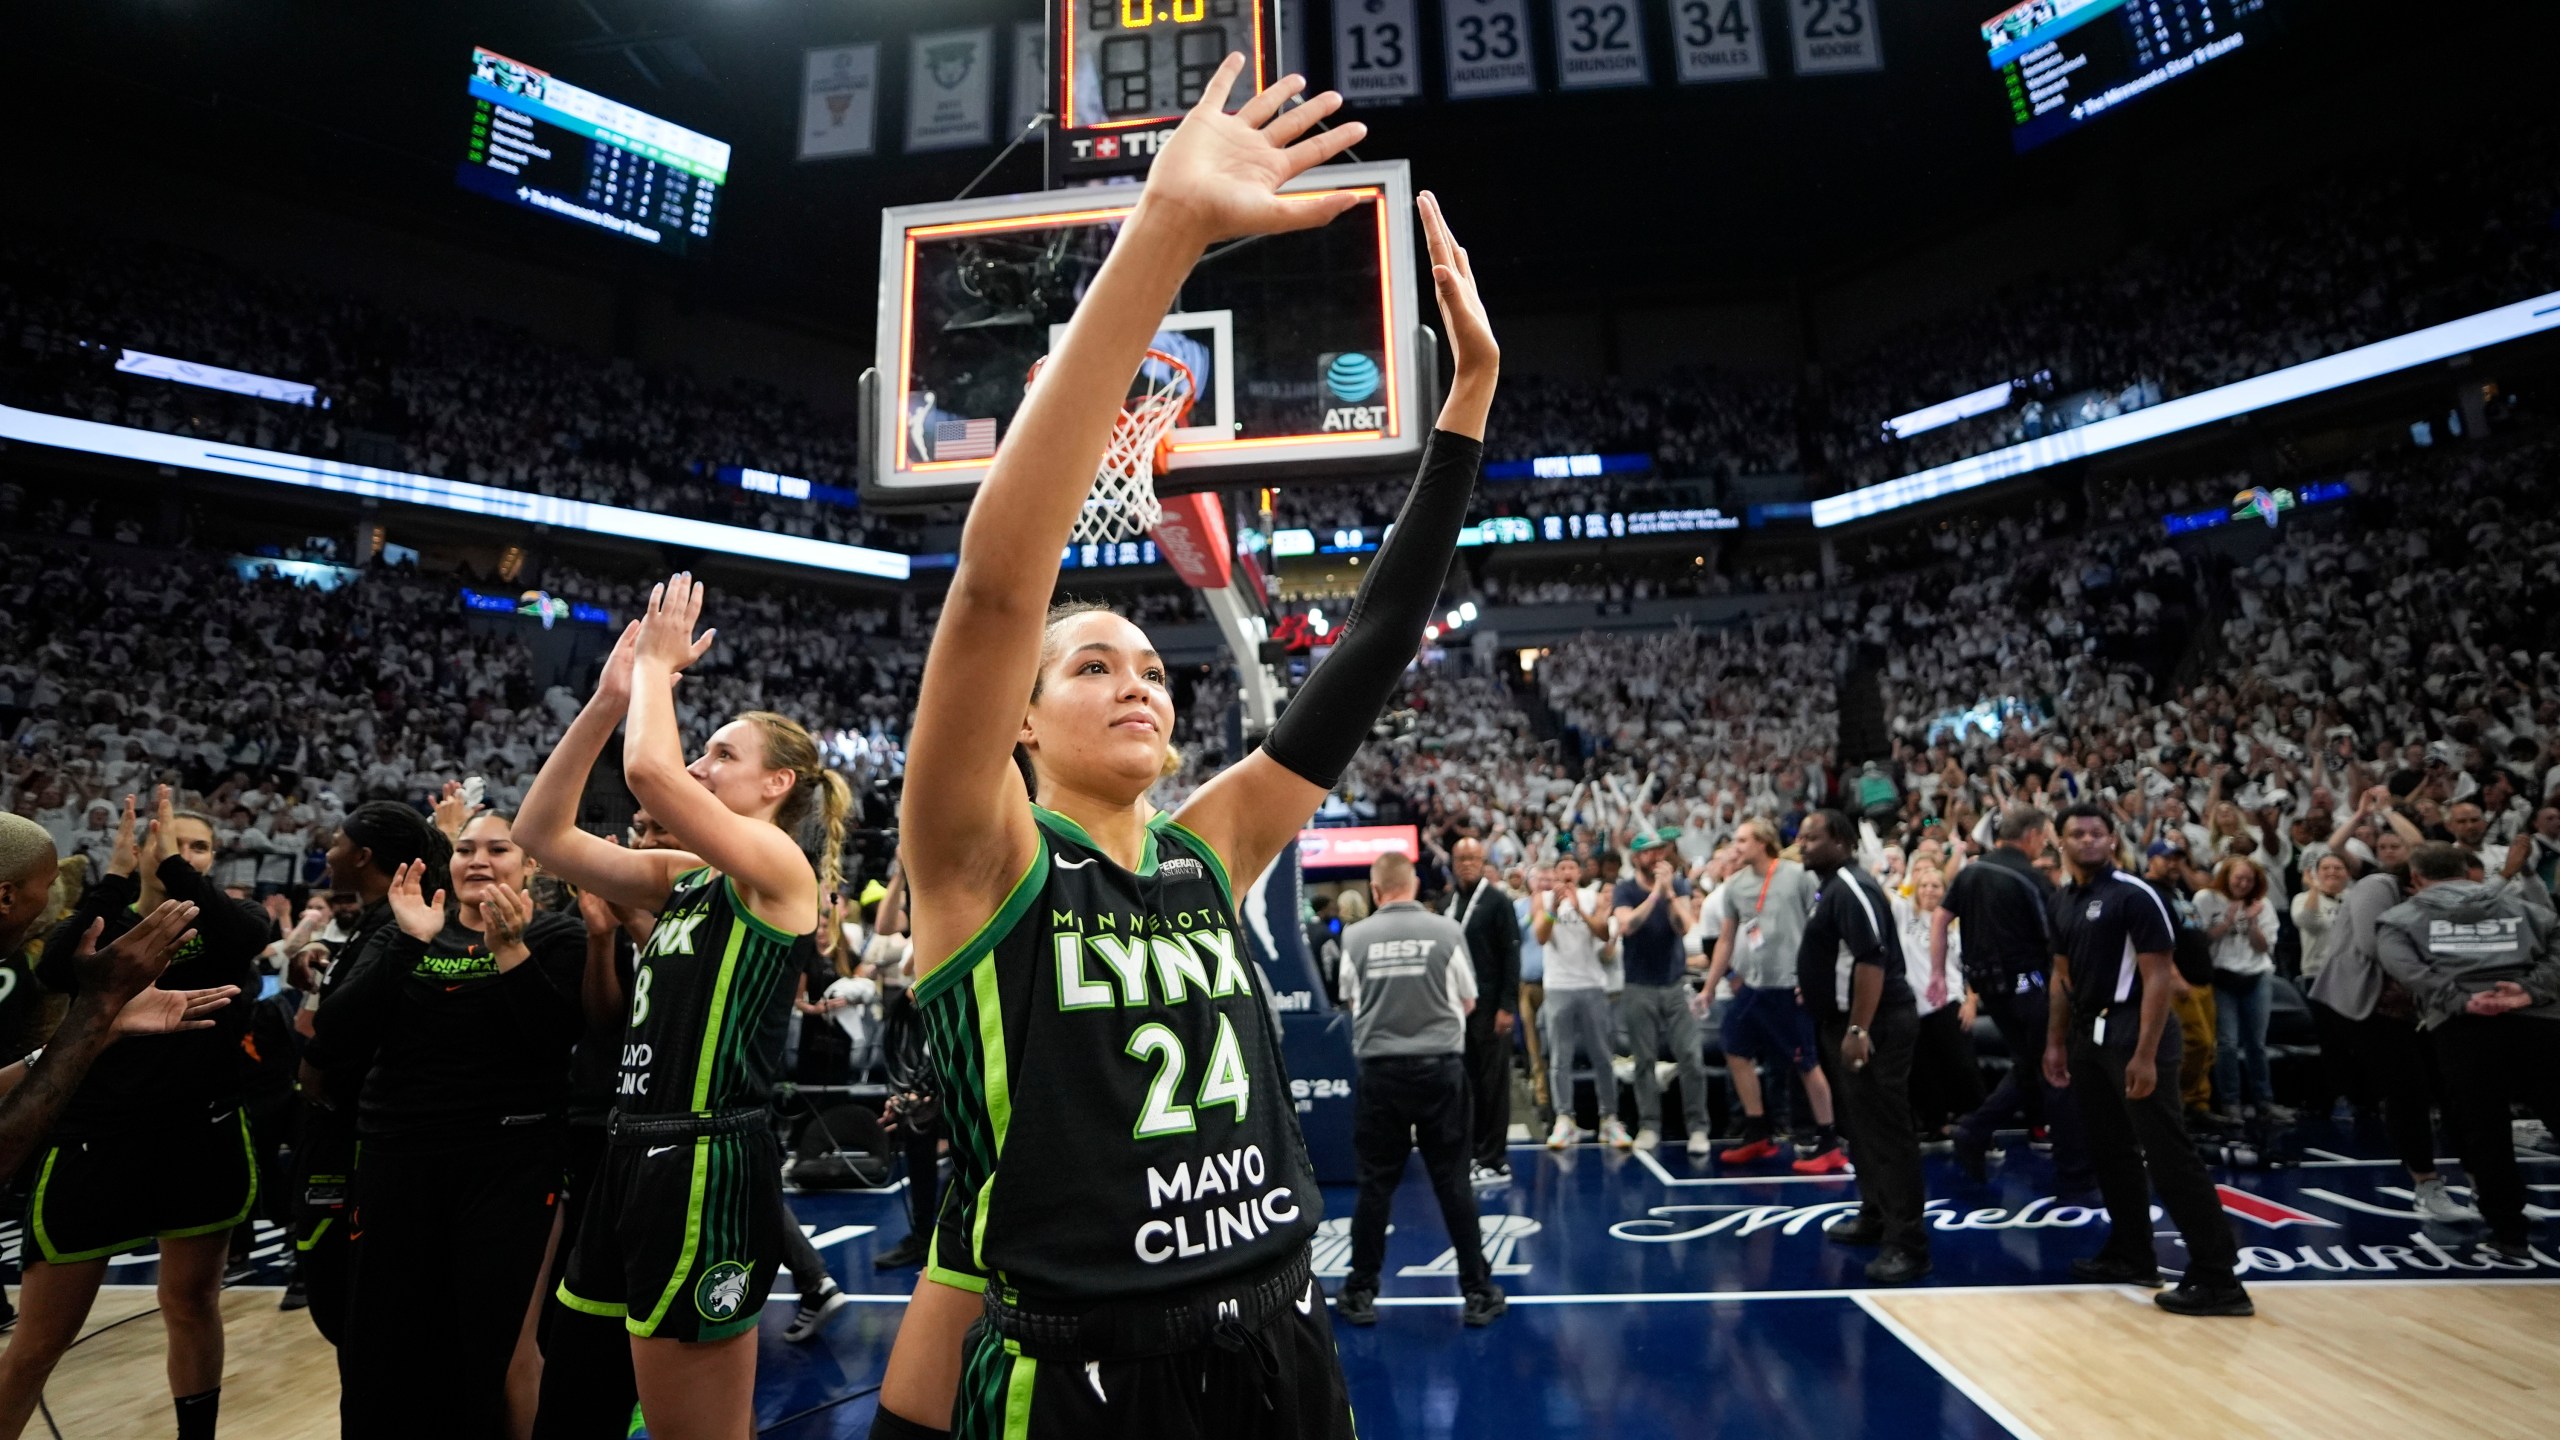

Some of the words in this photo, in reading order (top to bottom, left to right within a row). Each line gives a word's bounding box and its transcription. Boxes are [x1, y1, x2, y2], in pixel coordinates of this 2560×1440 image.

[1457, 12, 1519, 62] 33
[1567, 4, 1631, 51] 32
[1682, 0, 1749, 47] 34
[1803, 0, 1863, 38] 23
[1348, 23, 1402, 69] 13
[1566, 53, 1637, 73] BRUNSON
[1690, 49, 1749, 66] FOWLES
[1809, 40, 1862, 59] MOORE
[1322, 406, 1387, 431] AT&T
[1159, 858, 1203, 871] FEDERATED
[2429, 916, 2523, 936] BEST
[1054, 928, 1252, 1012] LYNX
[1367, 939, 1437, 961] BEST
[1125, 1012, 1249, 1141] 24
[1147, 1144, 1265, 1209] MAYO
[1134, 1187, 1300, 1264] CLINIC
